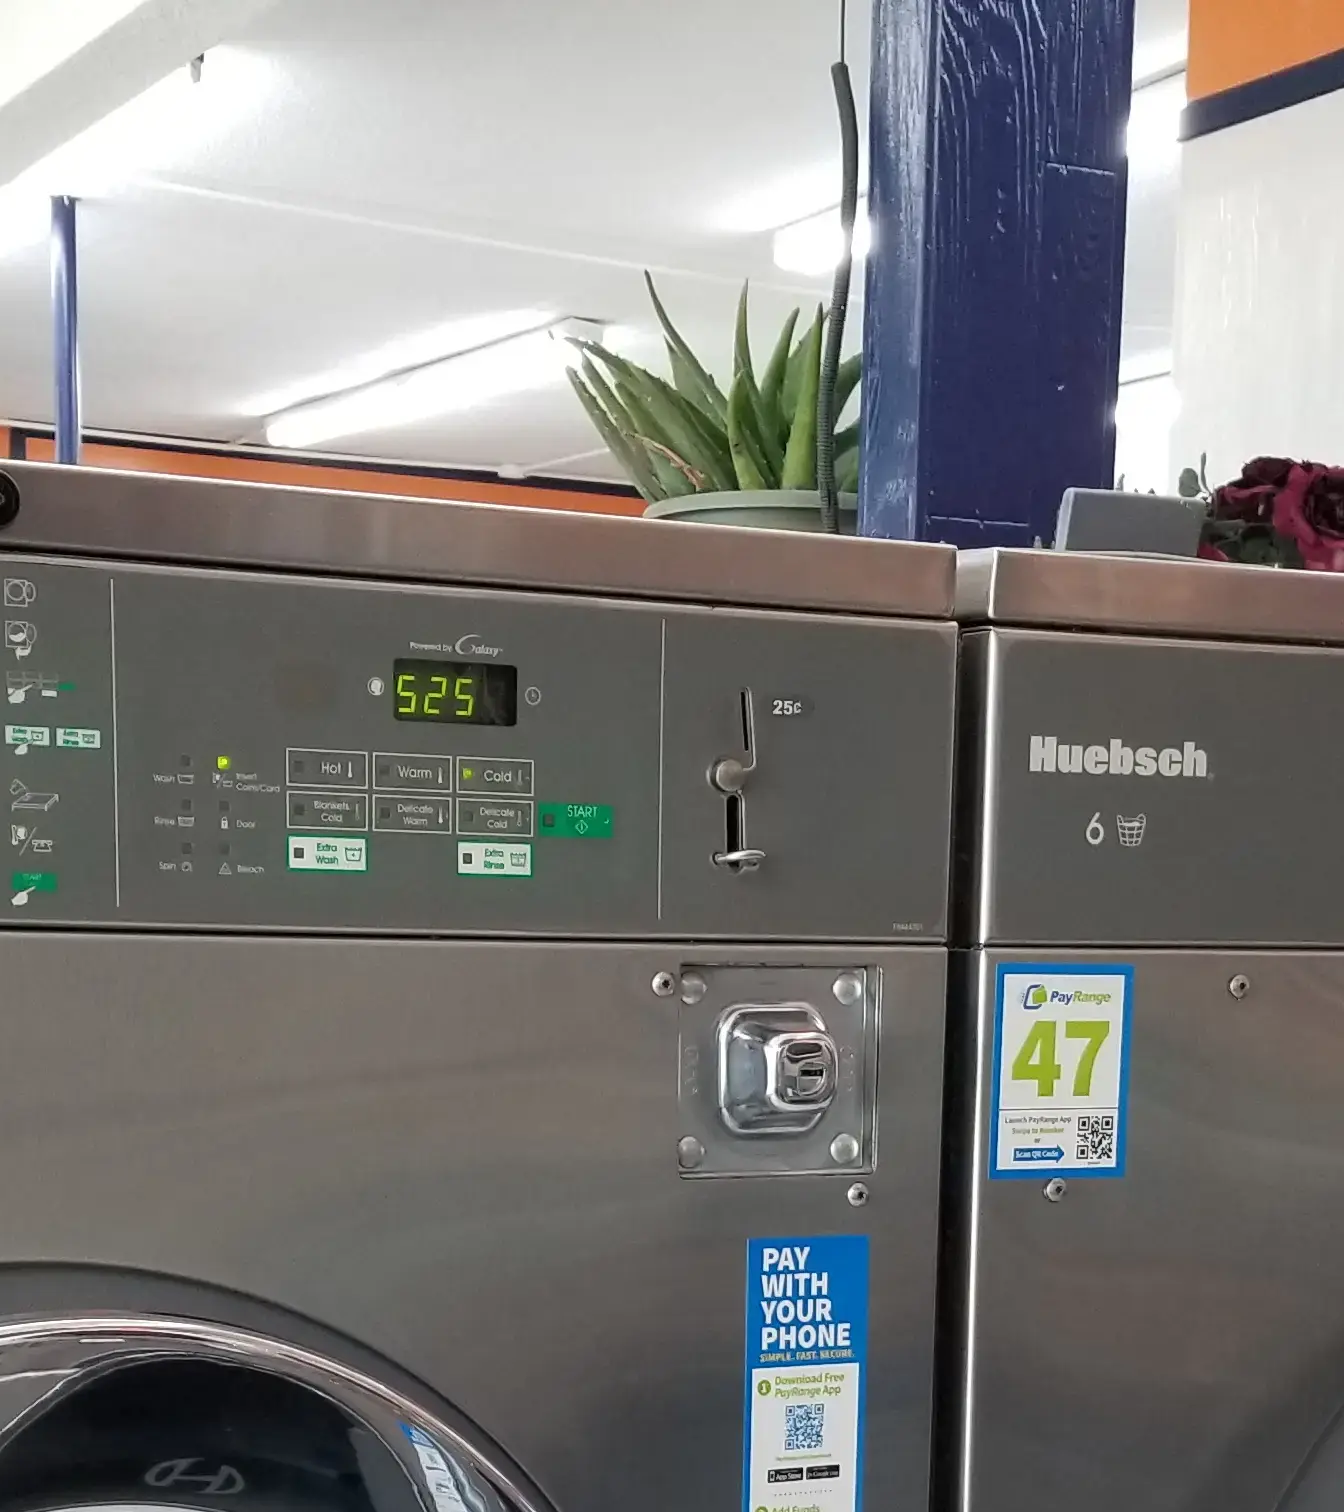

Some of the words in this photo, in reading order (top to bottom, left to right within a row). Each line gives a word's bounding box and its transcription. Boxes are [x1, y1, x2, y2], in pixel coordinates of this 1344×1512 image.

[1029, 736, 1207, 778] Huebsch
[321, 763, 341, 774] Hot
[397, 765, 432, 779] Warm
[484, 770, 512, 783] Cold
[397, 804, 434, 814] Delicate
[480, 807, 515, 817] Delicate
[567, 805, 598, 817] START
[403, 816, 428, 826] Warm
[487, 820, 508, 829] Cold
[1086, 812, 1105, 845] 6
[316, 843, 337, 852] Extra
[316, 855, 339, 865] Wash
[1050, 990, 1111, 1005] PayRange
[1012, 1020, 1110, 1097] 47
[762, 1246, 811, 1272] PAY
[761, 1272, 828, 1298] WITH
[760, 1298, 832, 1325] YOUR
[761, 1323, 851, 1351] PHONE
[775, 1372, 822, 1385] Download
[825, 1373, 845, 1382] Free
[775, 1386, 821, 1399] PayRange
[823, 1386, 841, 1396] App
